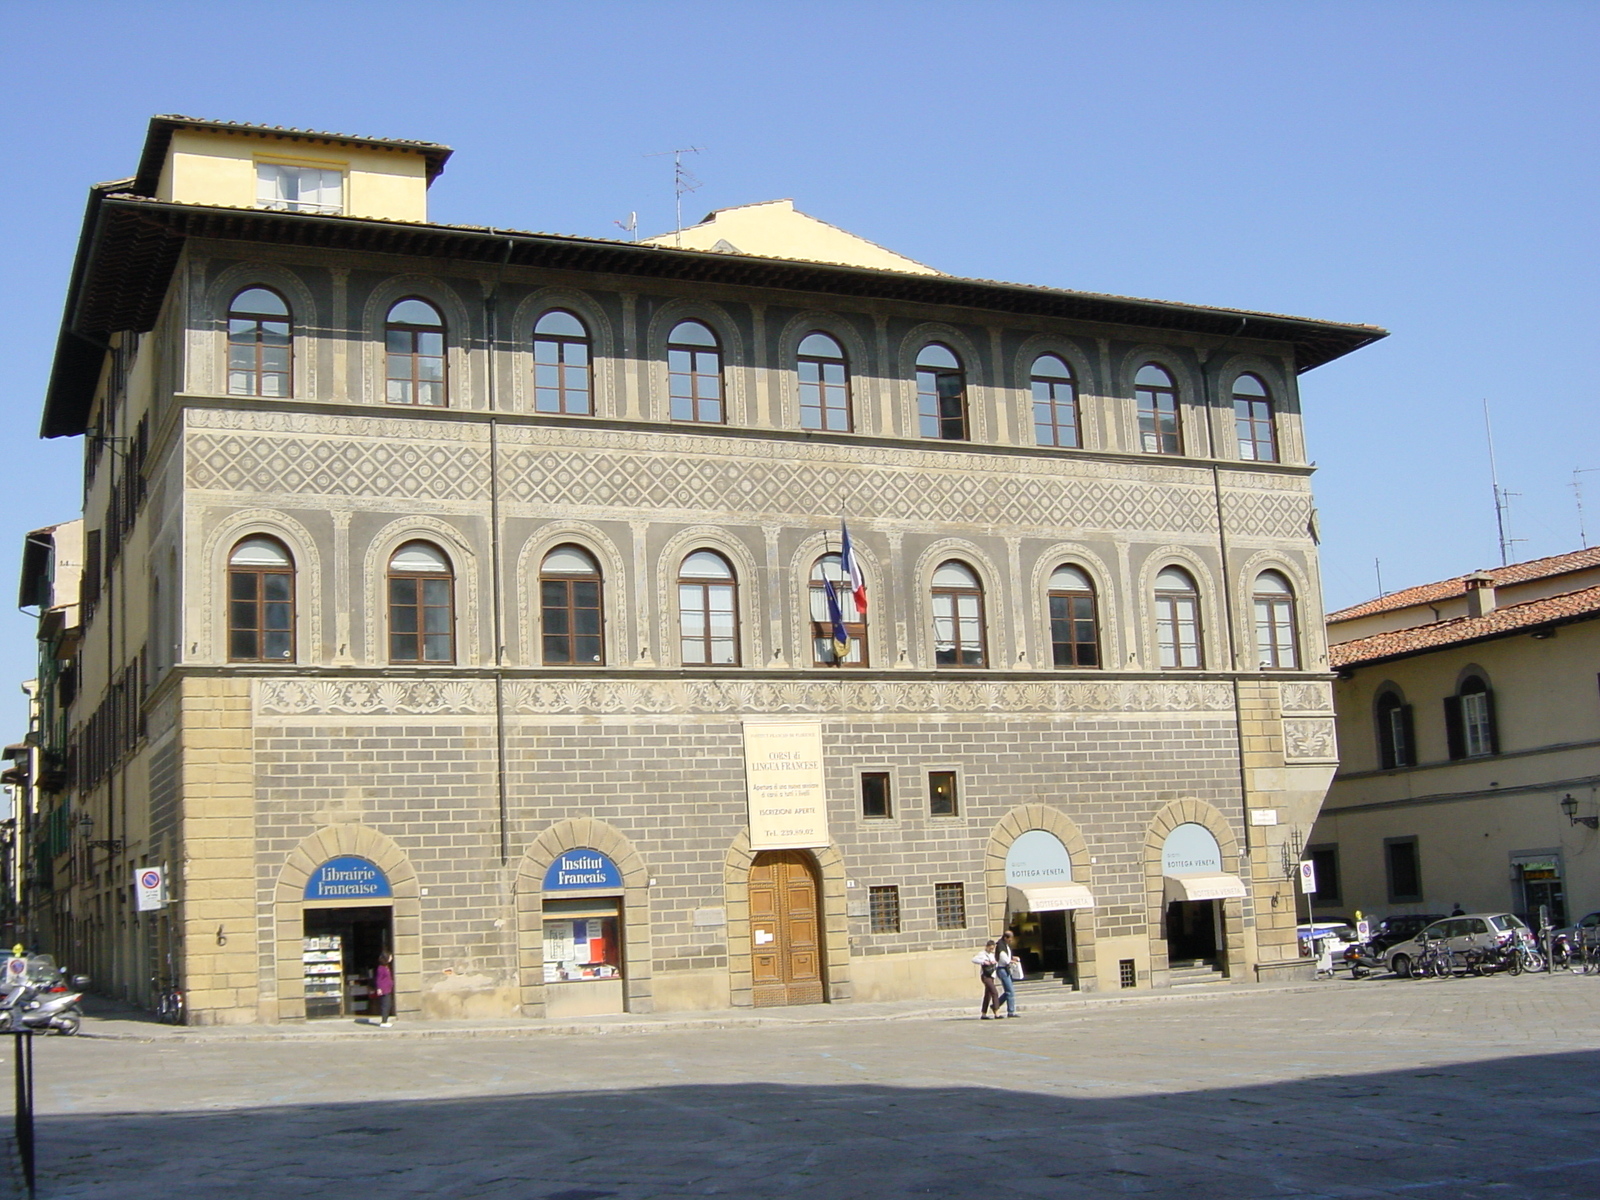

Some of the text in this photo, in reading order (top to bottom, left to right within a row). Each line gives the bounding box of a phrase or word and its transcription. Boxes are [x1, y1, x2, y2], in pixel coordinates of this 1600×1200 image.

[769, 751, 801, 760] CORSI di
[752, 761, 819, 771] LINGUA FRANCESE
[759, 807, 816, 816] ISCRIZIONI APERTE
[561, 856, 603, 871] Institut
[1167, 859, 1215, 868] BOTTEGA VENETA
[321, 866, 376, 881] Librairie
[1011, 868, 1065, 878] BOTTEGA VENETA
